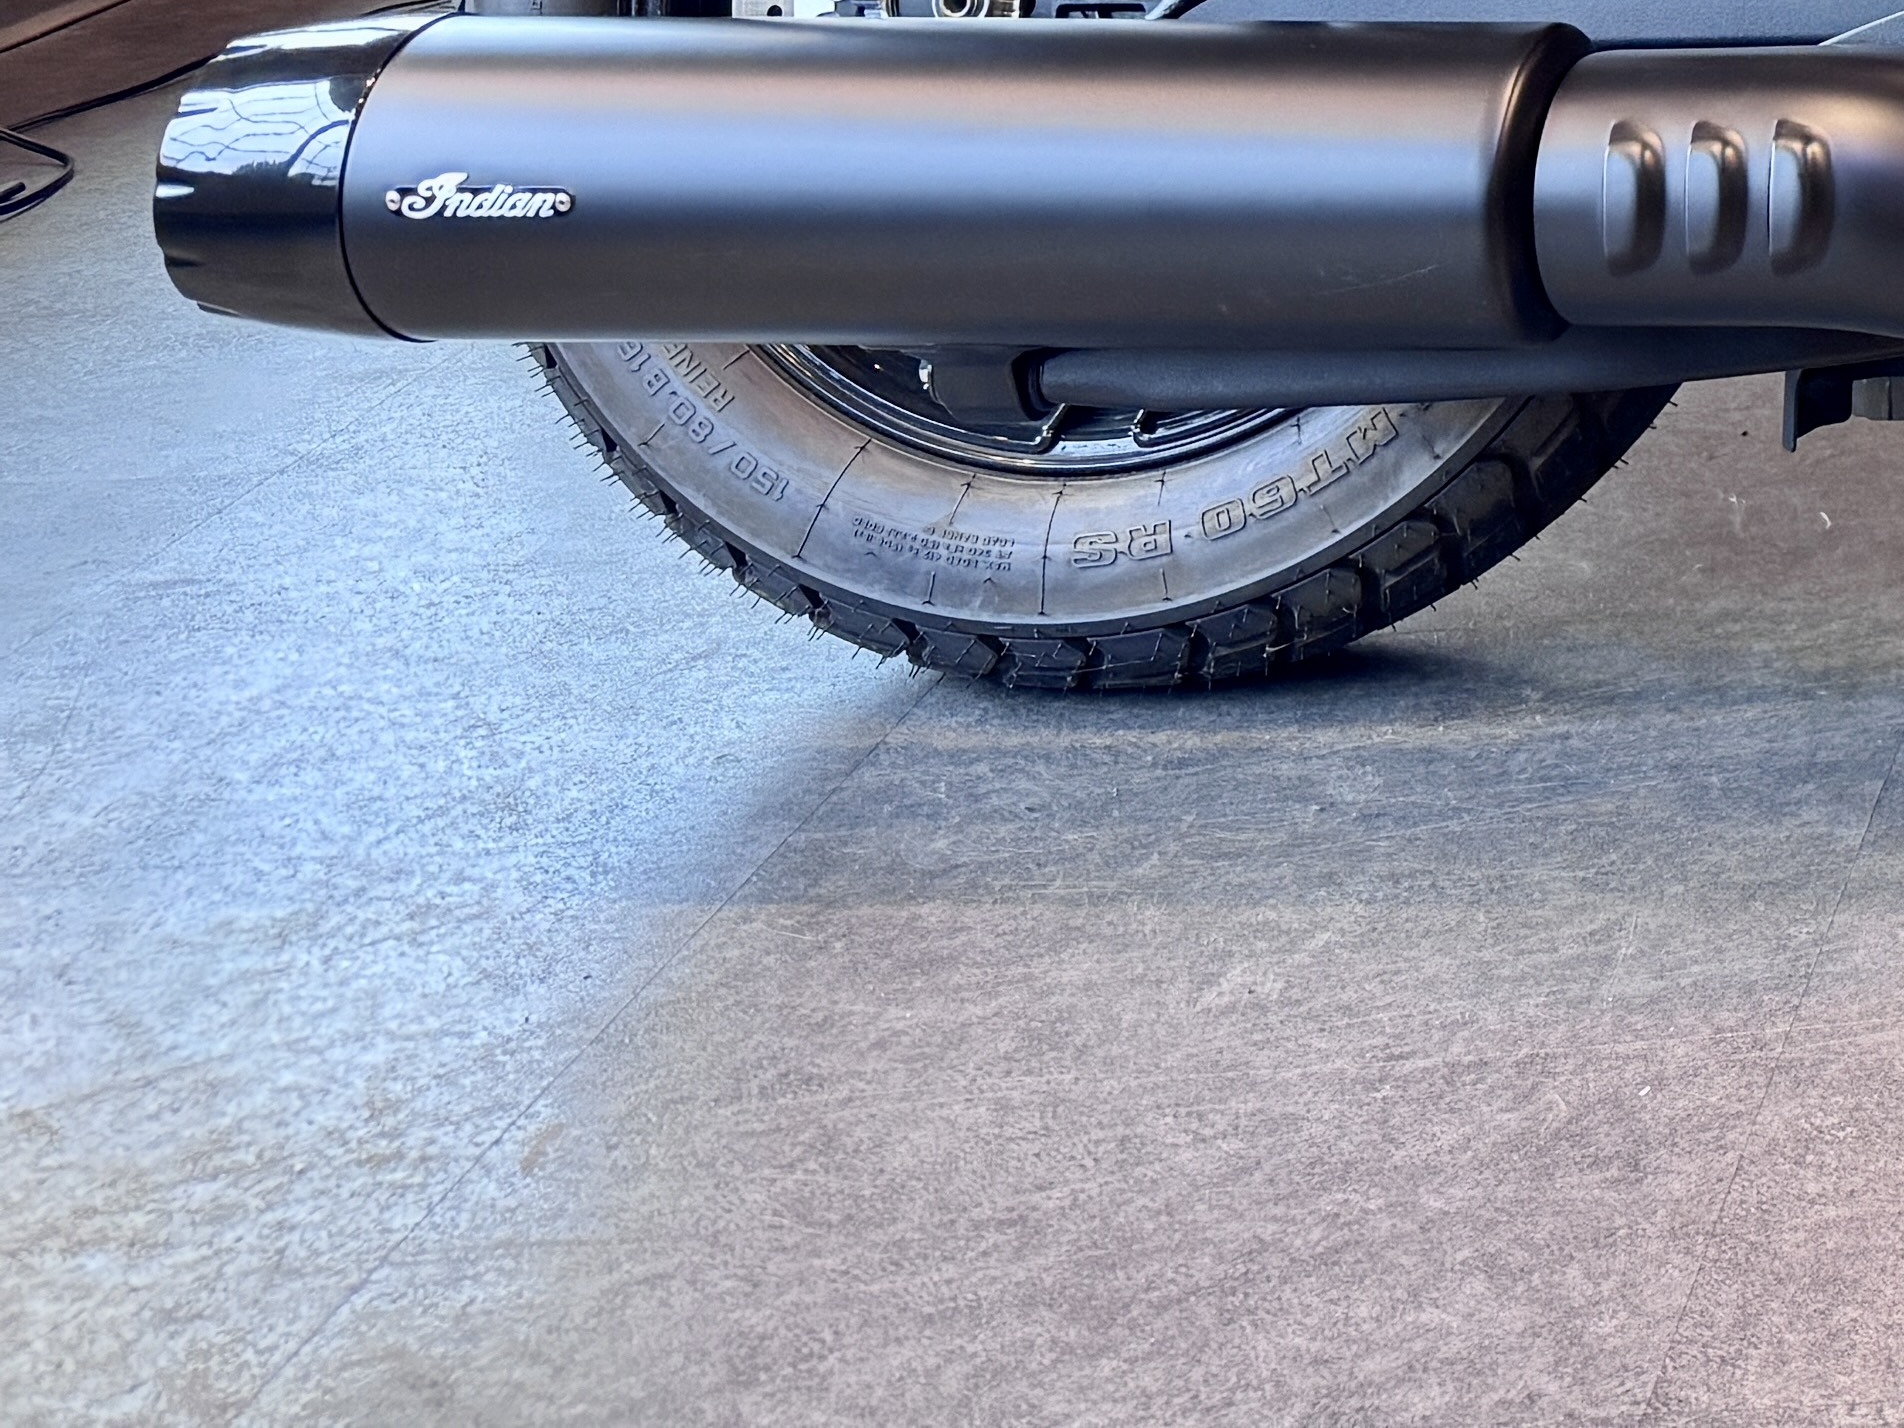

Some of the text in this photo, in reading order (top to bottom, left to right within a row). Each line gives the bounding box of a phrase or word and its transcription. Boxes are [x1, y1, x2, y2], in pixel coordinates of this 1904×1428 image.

[400, 172, 556, 220] Indian
[1072, 407, 1398, 568] MT60 RS
